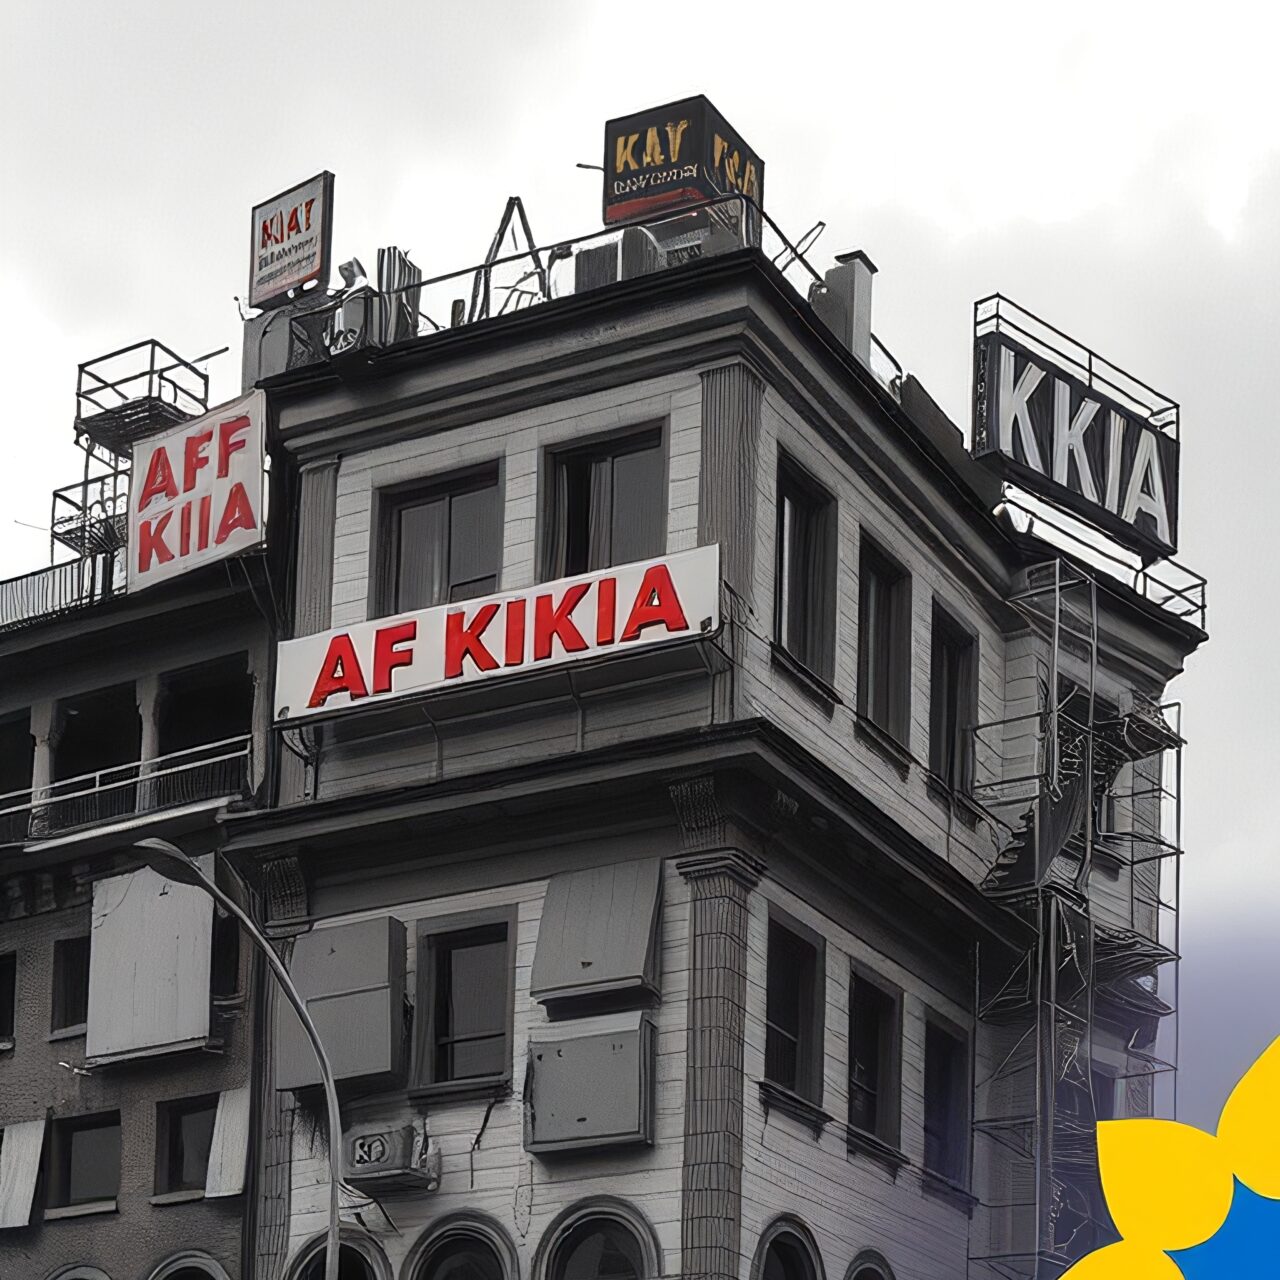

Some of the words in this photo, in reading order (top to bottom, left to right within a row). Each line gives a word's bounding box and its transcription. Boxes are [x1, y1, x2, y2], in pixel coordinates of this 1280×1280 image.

[138, 415, 251, 514] AFF
[999, 344, 1176, 549] KKIA
[138, 481, 257, 573] KIIA
[306, 620, 418, 708] AF
[444, 564, 689, 680] KIKIA
